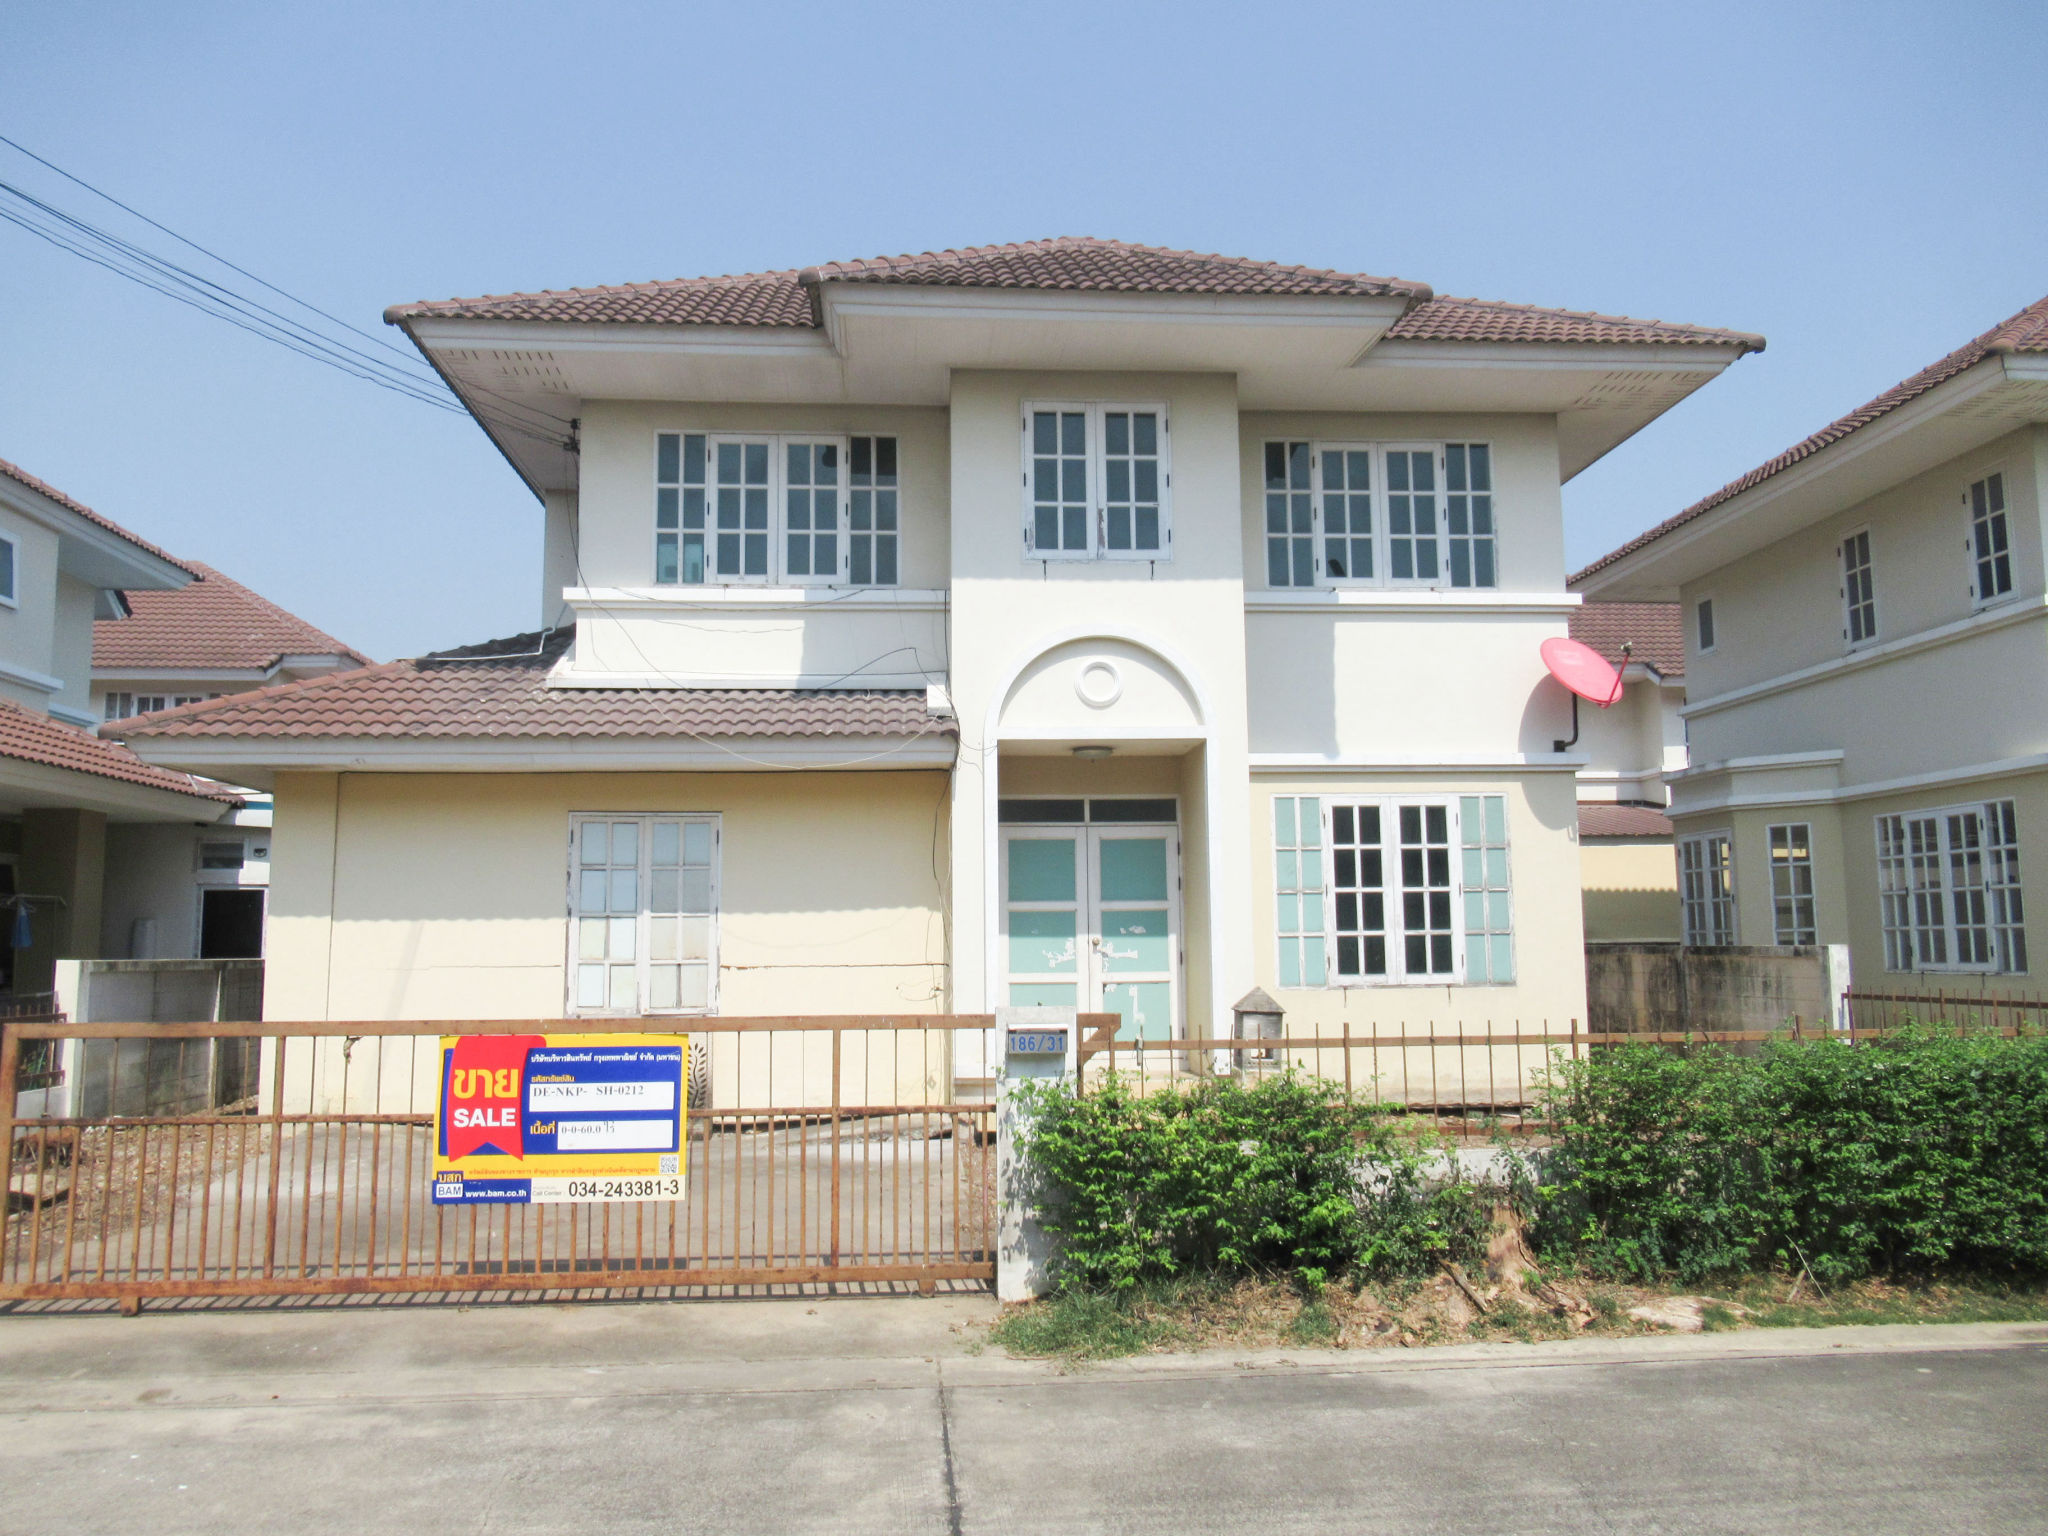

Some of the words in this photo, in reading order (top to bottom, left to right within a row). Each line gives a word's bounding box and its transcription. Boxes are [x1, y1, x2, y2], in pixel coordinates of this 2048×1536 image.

[1011, 1034, 1064, 1052] 186/31
[453, 1068, 519, 1099] ขาย
[533, 1086, 588, 1097] DE-NKP-
[595, 1085, 645, 1096] SH-0212
[453, 1107, 517, 1128] SALE
[530, 1119, 557, 1135] เนื้อที่
[438, 1185, 462, 1196] BAM
[465, 1188, 527, 1198] www.bam.co.th
[568, 1179, 680, 1198] 034-243381-3
